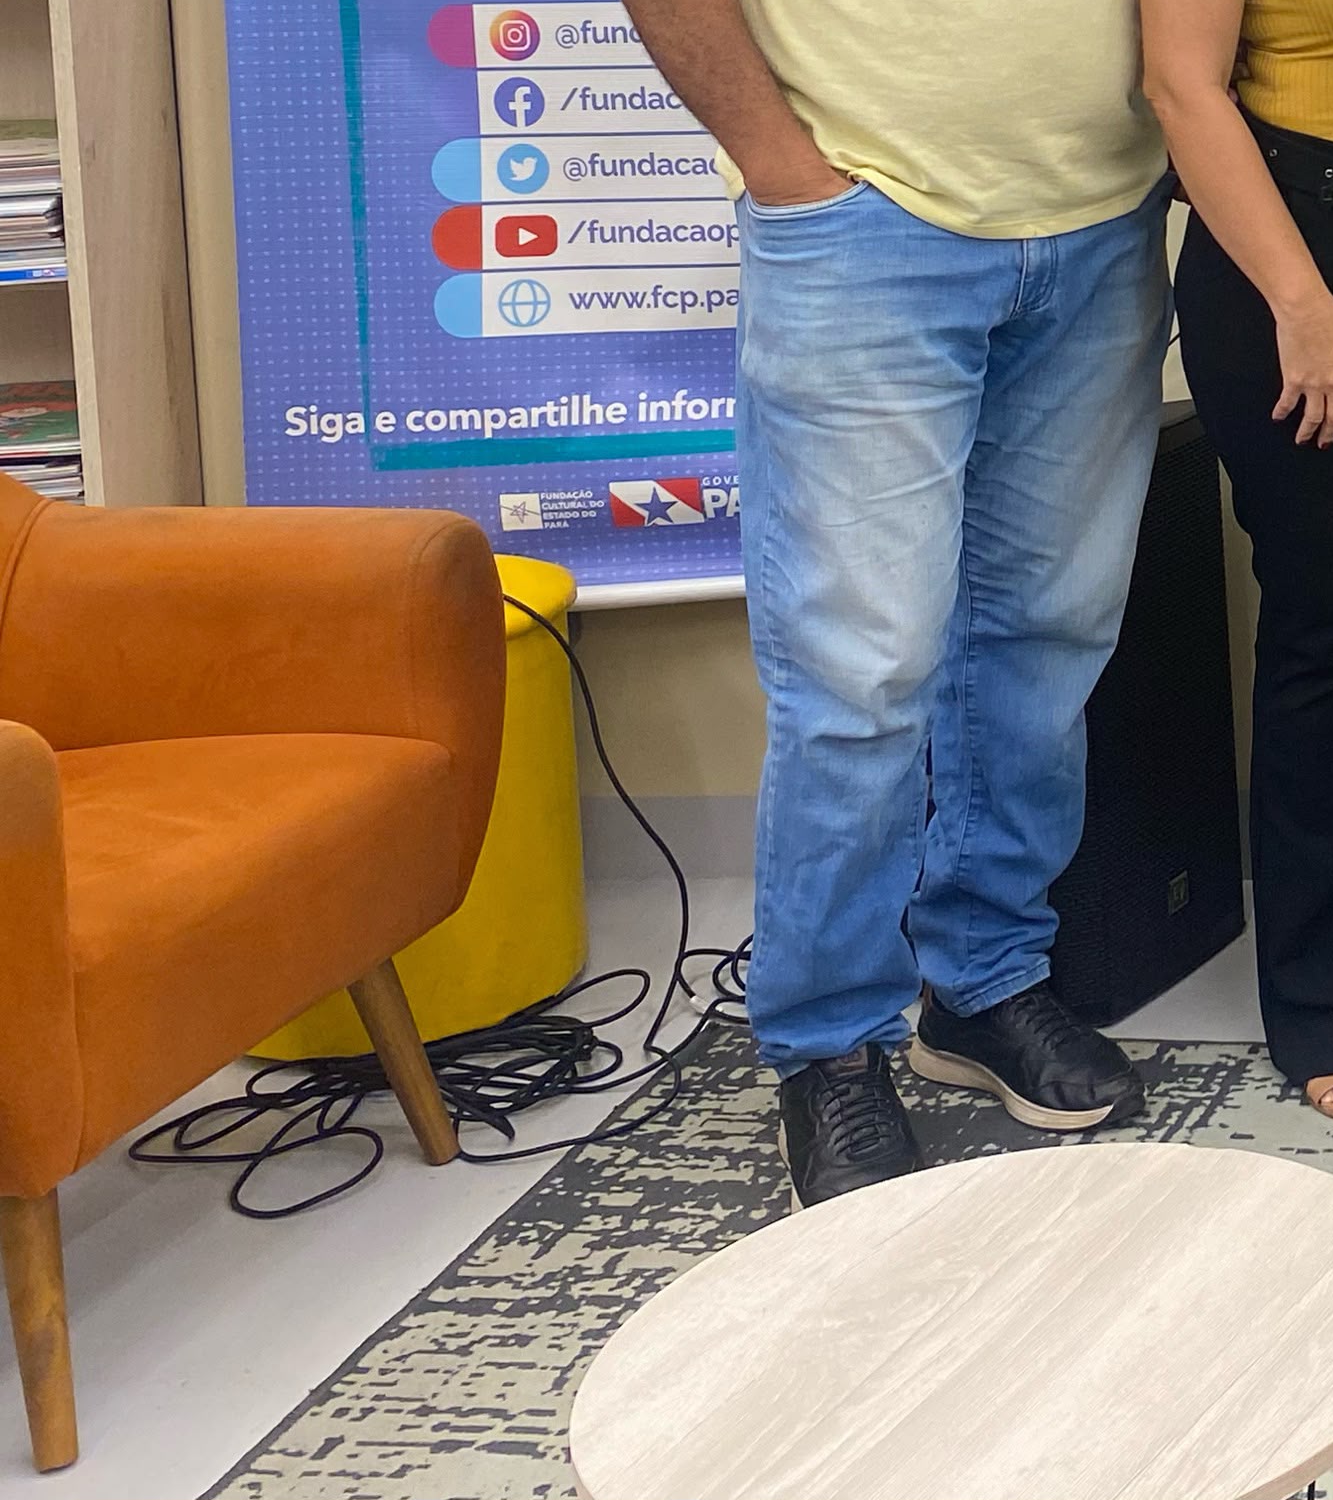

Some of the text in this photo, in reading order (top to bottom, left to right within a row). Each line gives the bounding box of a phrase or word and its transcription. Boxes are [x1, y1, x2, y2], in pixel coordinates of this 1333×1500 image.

[284, 405, 365, 443] Siga
[375, 413, 396, 434] e
[405, 395, 627, 437] compartilhe
[540, 490, 593, 500] FUNDAÇÃO
[542, 500, 605, 511] CULTURAL DO
[543, 510, 597, 521] ESTADO DO
